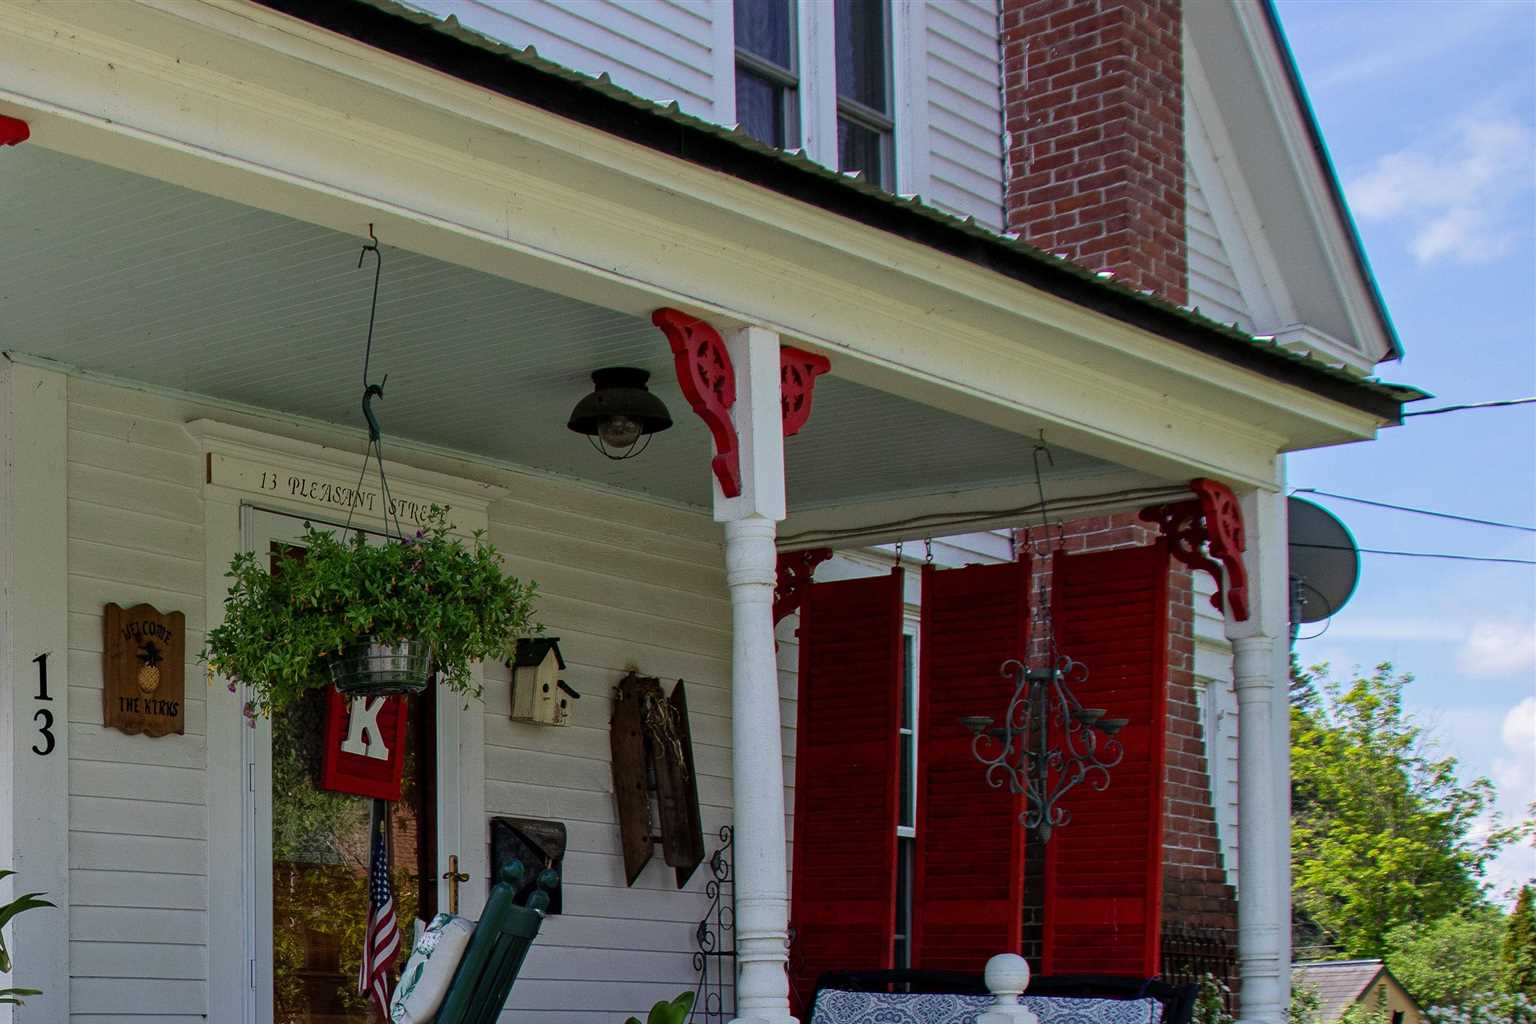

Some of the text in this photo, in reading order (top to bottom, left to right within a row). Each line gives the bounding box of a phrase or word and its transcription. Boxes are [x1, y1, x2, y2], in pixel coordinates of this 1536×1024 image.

[260, 471, 277, 490] 13
[288, 476, 376, 511] PLEASANT
[122, 621, 171, 645] WELCOME
[120, 696, 139, 713] THE
[341, 696, 389, 761] K
